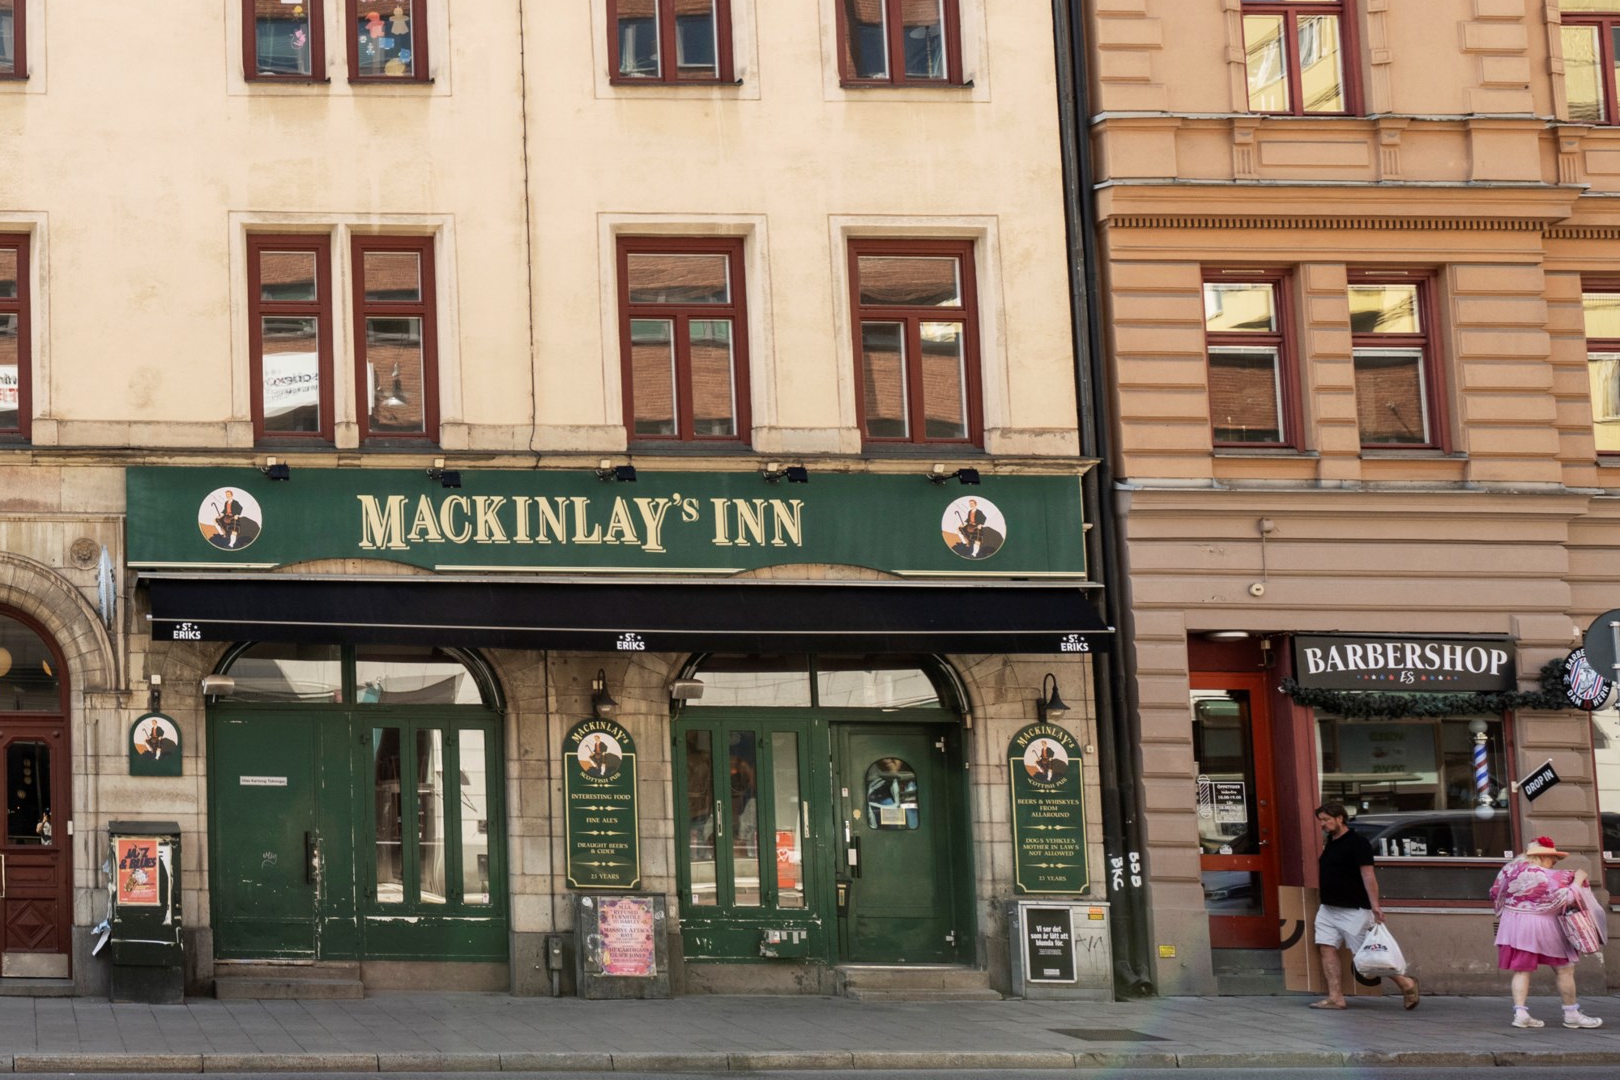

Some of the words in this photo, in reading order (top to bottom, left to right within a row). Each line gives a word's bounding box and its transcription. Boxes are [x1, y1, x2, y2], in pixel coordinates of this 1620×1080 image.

[710, 497, 804, 547] INN
[173, 630, 201, 640] ERIKS
[616, 640, 645, 650] ERIKS
[1060, 642, 1088, 652] ERIKS
[1304, 642, 1508, 676] BARBERSHOP
[1399, 670, 1415, 684] ES
[1566, 689, 1582, 707] DAM
[1592, 685, 1610, 707] HERR
[580, 772, 608, 783] SCOTTISH
[610, 772, 622, 781] PUB
[1028, 778, 1056, 788] SCOTTISH
[1056, 778, 1068, 787] PUB
[1525, 775, 1542, 796] DROP
[1542, 768, 1554, 781] IN
[129, 858, 156, 868] BLUES
